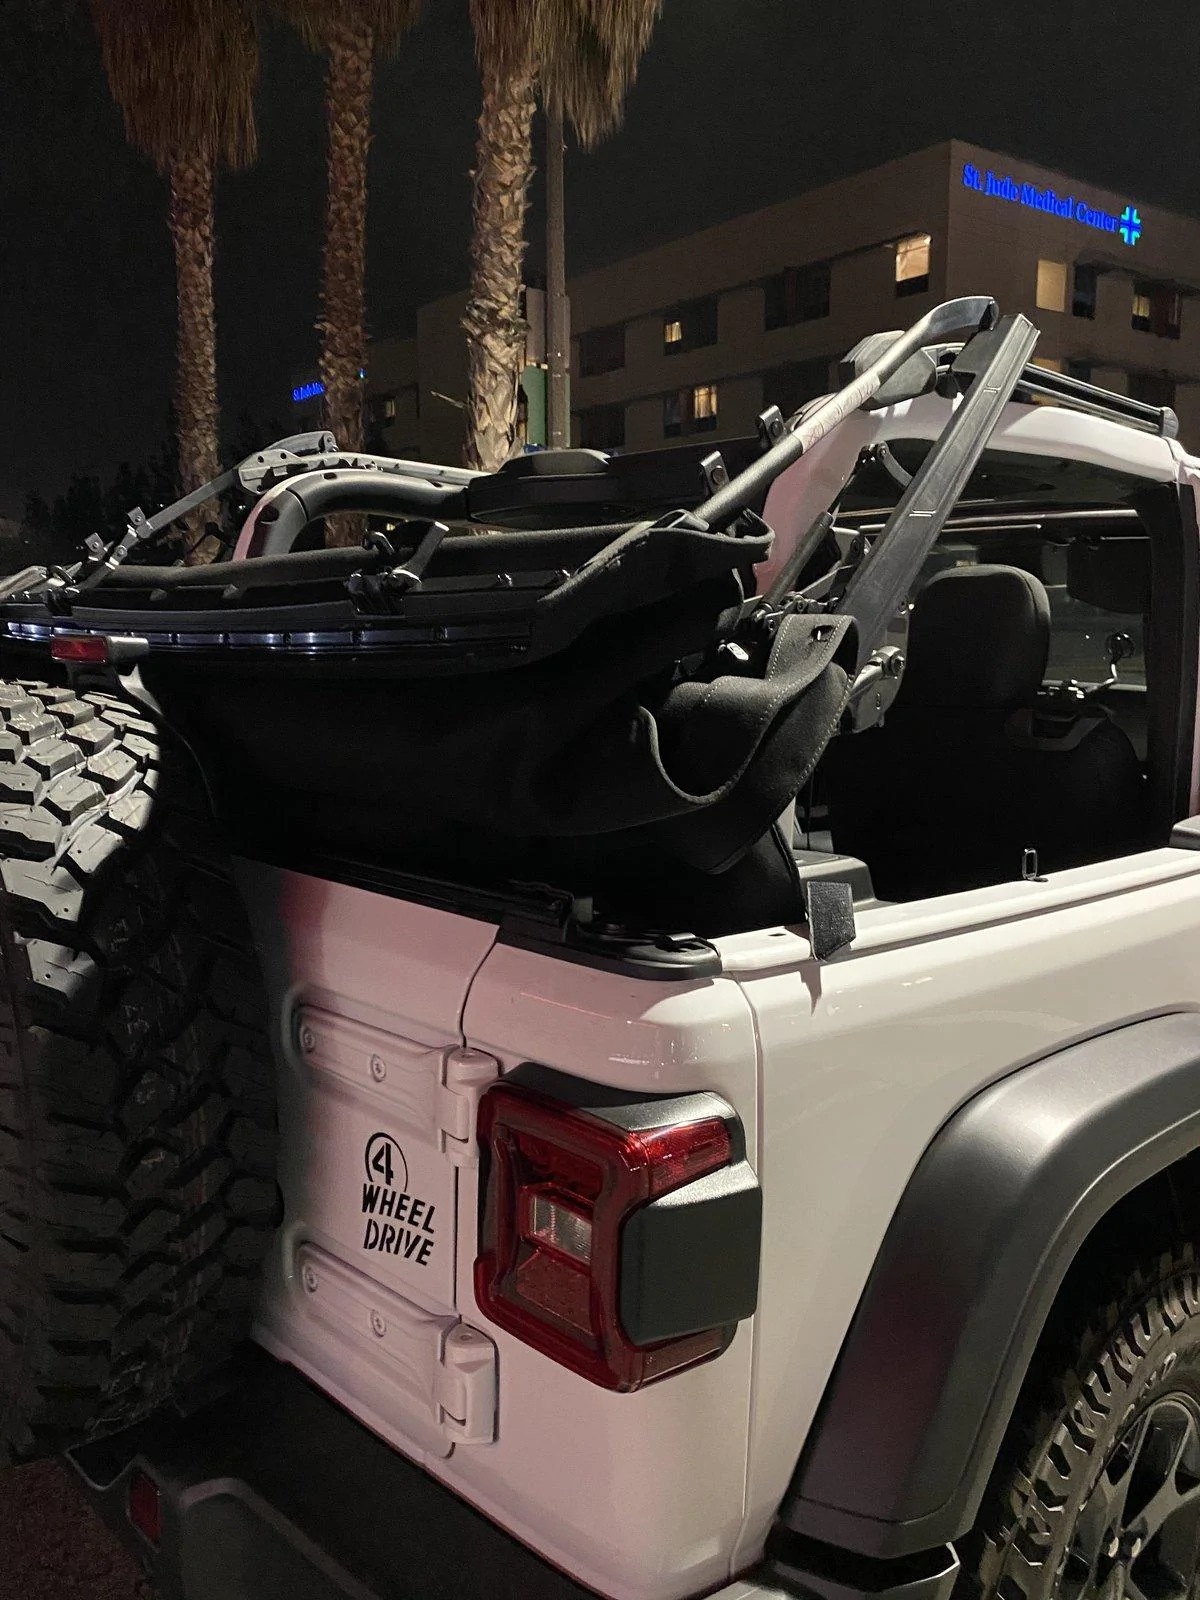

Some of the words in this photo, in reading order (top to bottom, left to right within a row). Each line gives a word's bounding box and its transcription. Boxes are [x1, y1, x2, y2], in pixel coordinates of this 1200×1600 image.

[963, 162, 982, 191] St.
[985, 170, 1019, 201] Jude
[1021, 183, 1073, 219] Medical
[1076, 202, 1117, 232] Center
[372, 1142, 394, 1186] 4
[362, 1183, 436, 1234] WHEEL
[363, 1218, 434, 1266] DRIVE
